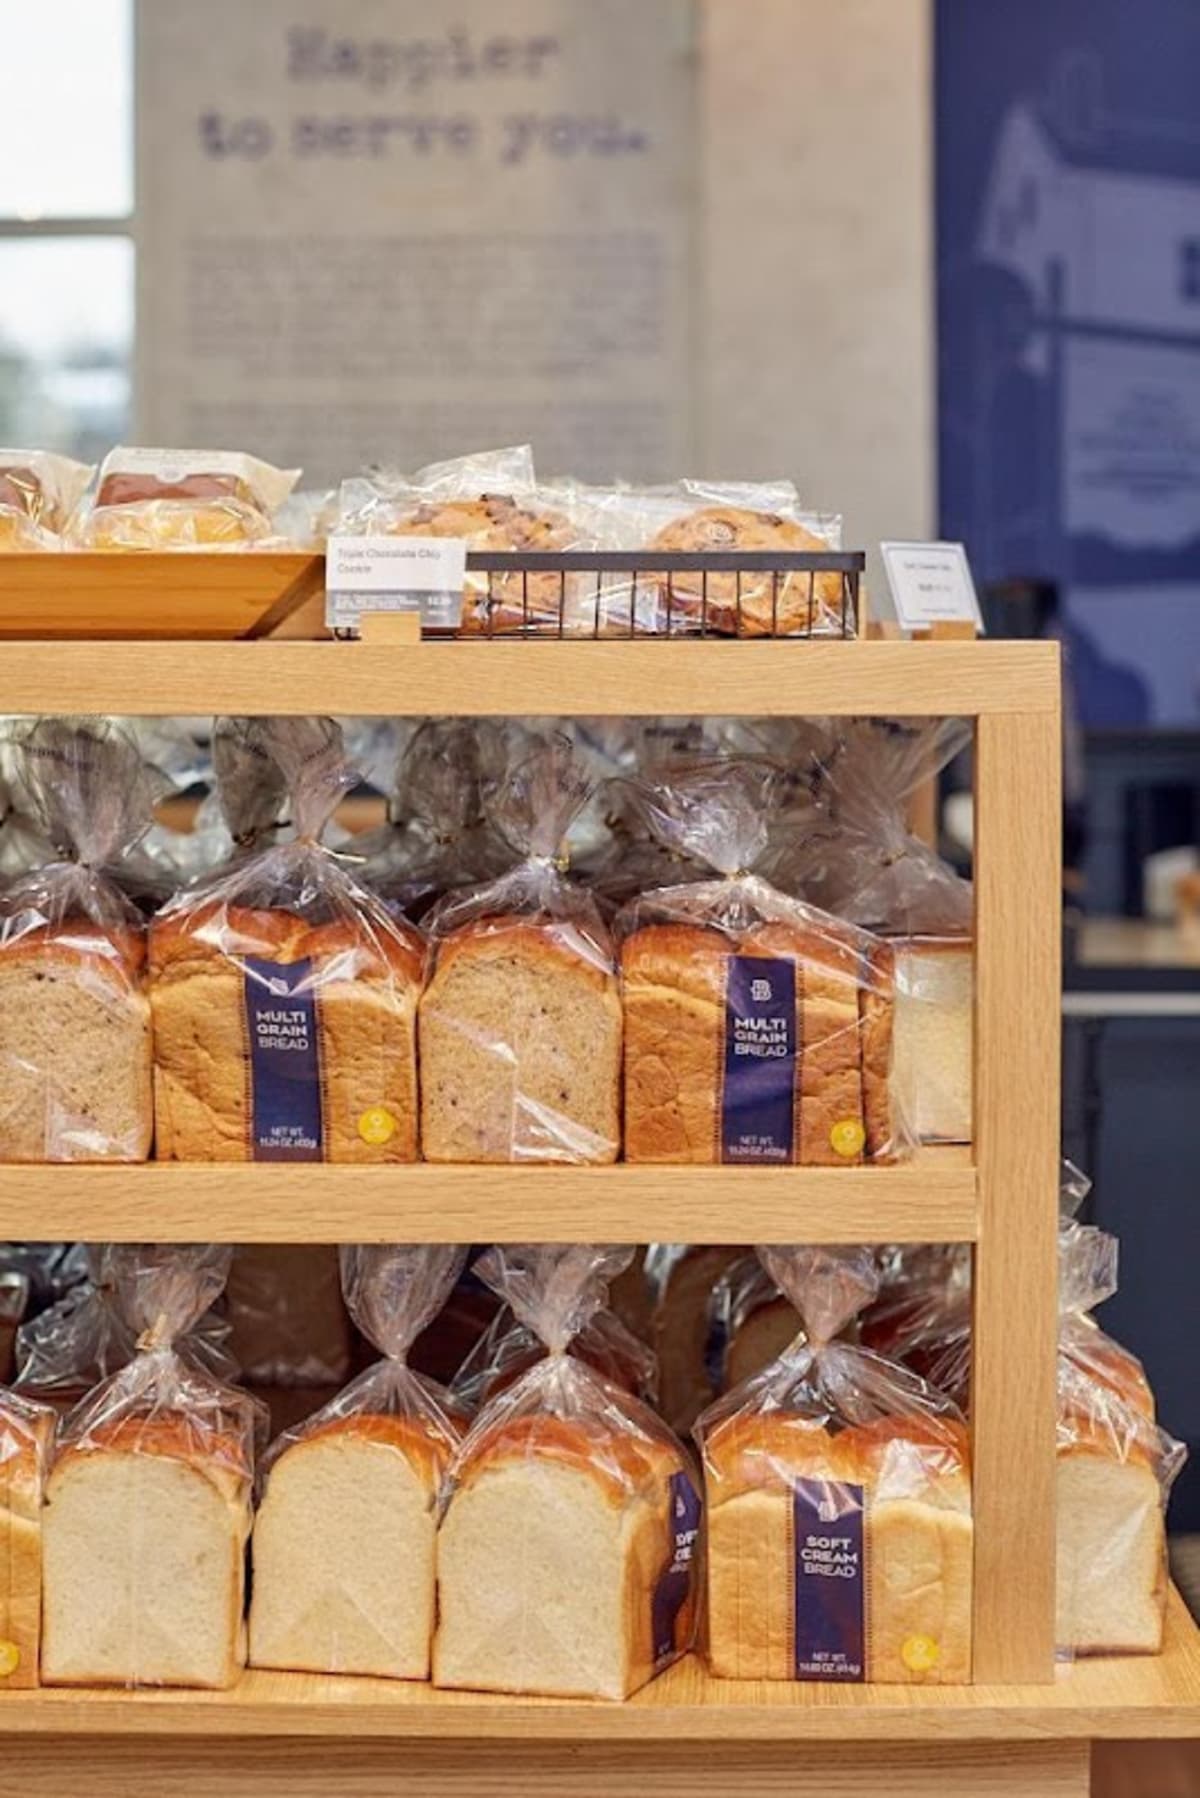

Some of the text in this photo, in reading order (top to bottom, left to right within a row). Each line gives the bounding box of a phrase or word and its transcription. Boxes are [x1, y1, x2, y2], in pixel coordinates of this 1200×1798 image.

[287, 24, 561, 94] Happier
[199, 111, 275, 161] to
[293, 113, 478, 160] serve
[366, 548, 417, 559] Chocolate
[256, 1010, 306, 1024] MULTI
[734, 1017, 787, 1030] MULTI
[256, 1023, 308, 1036] GRAIN
[257, 1037, 309, 1051] BREAD
[734, 1031, 788, 1043] GRAIN
[734, 1043, 788, 1057] BREAD
[271, 1126, 288, 1137] NET
[805, 1535, 852, 1550] SOFT
[800, 1549, 858, 1564] CREAM
[803, 1563, 857, 1579] BREAD
